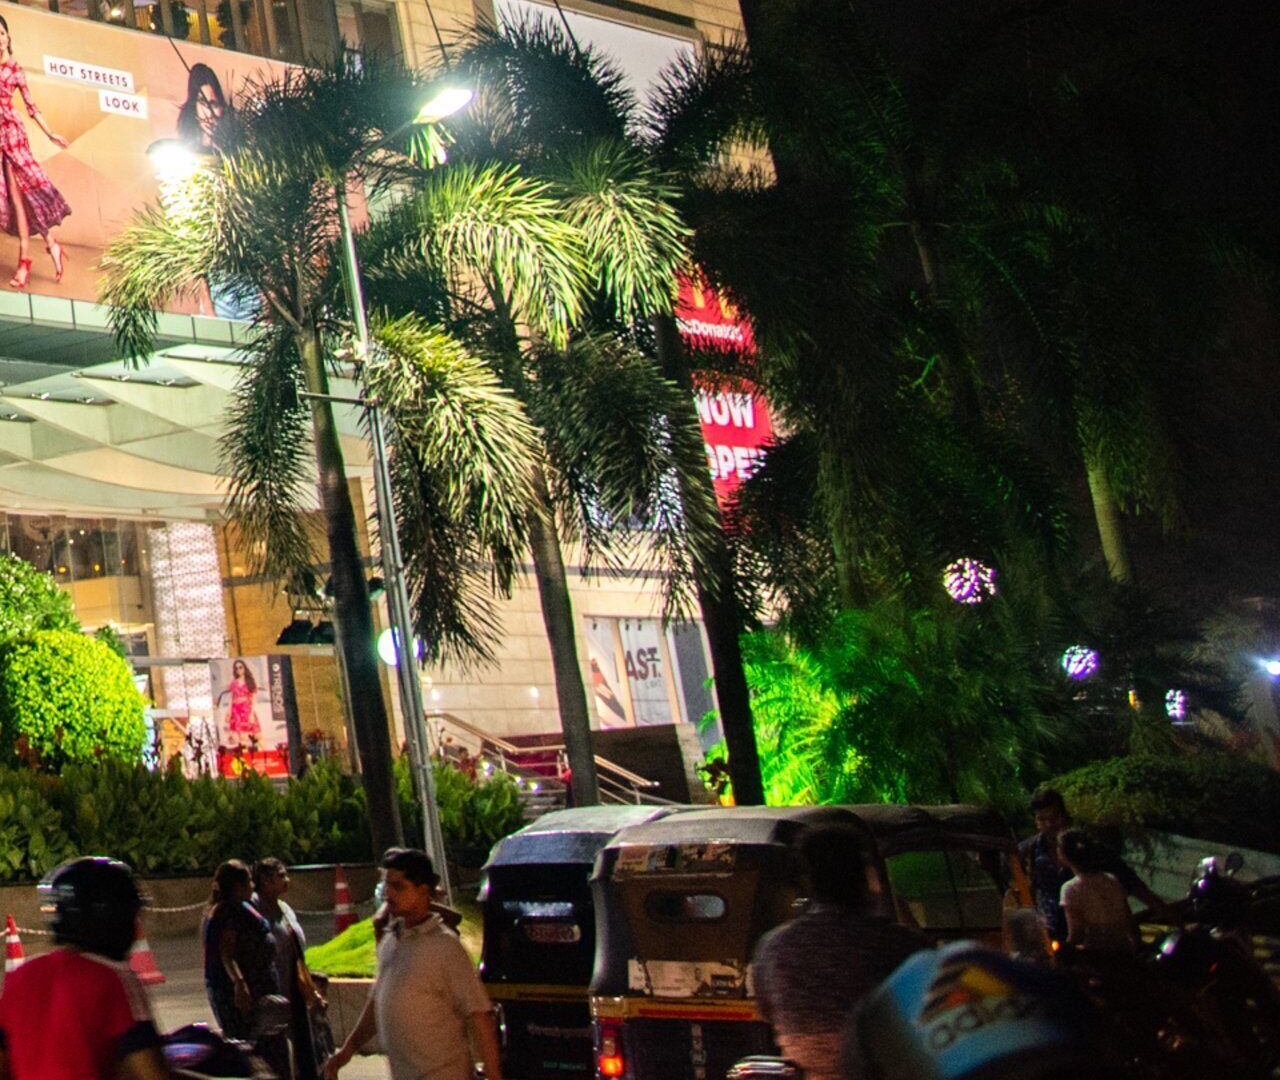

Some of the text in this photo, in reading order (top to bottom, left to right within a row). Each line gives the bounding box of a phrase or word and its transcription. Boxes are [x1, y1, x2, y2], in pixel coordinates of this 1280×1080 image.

[48, 60, 129, 89] HOT STREETS
[105, 94, 139, 113] LOOK
